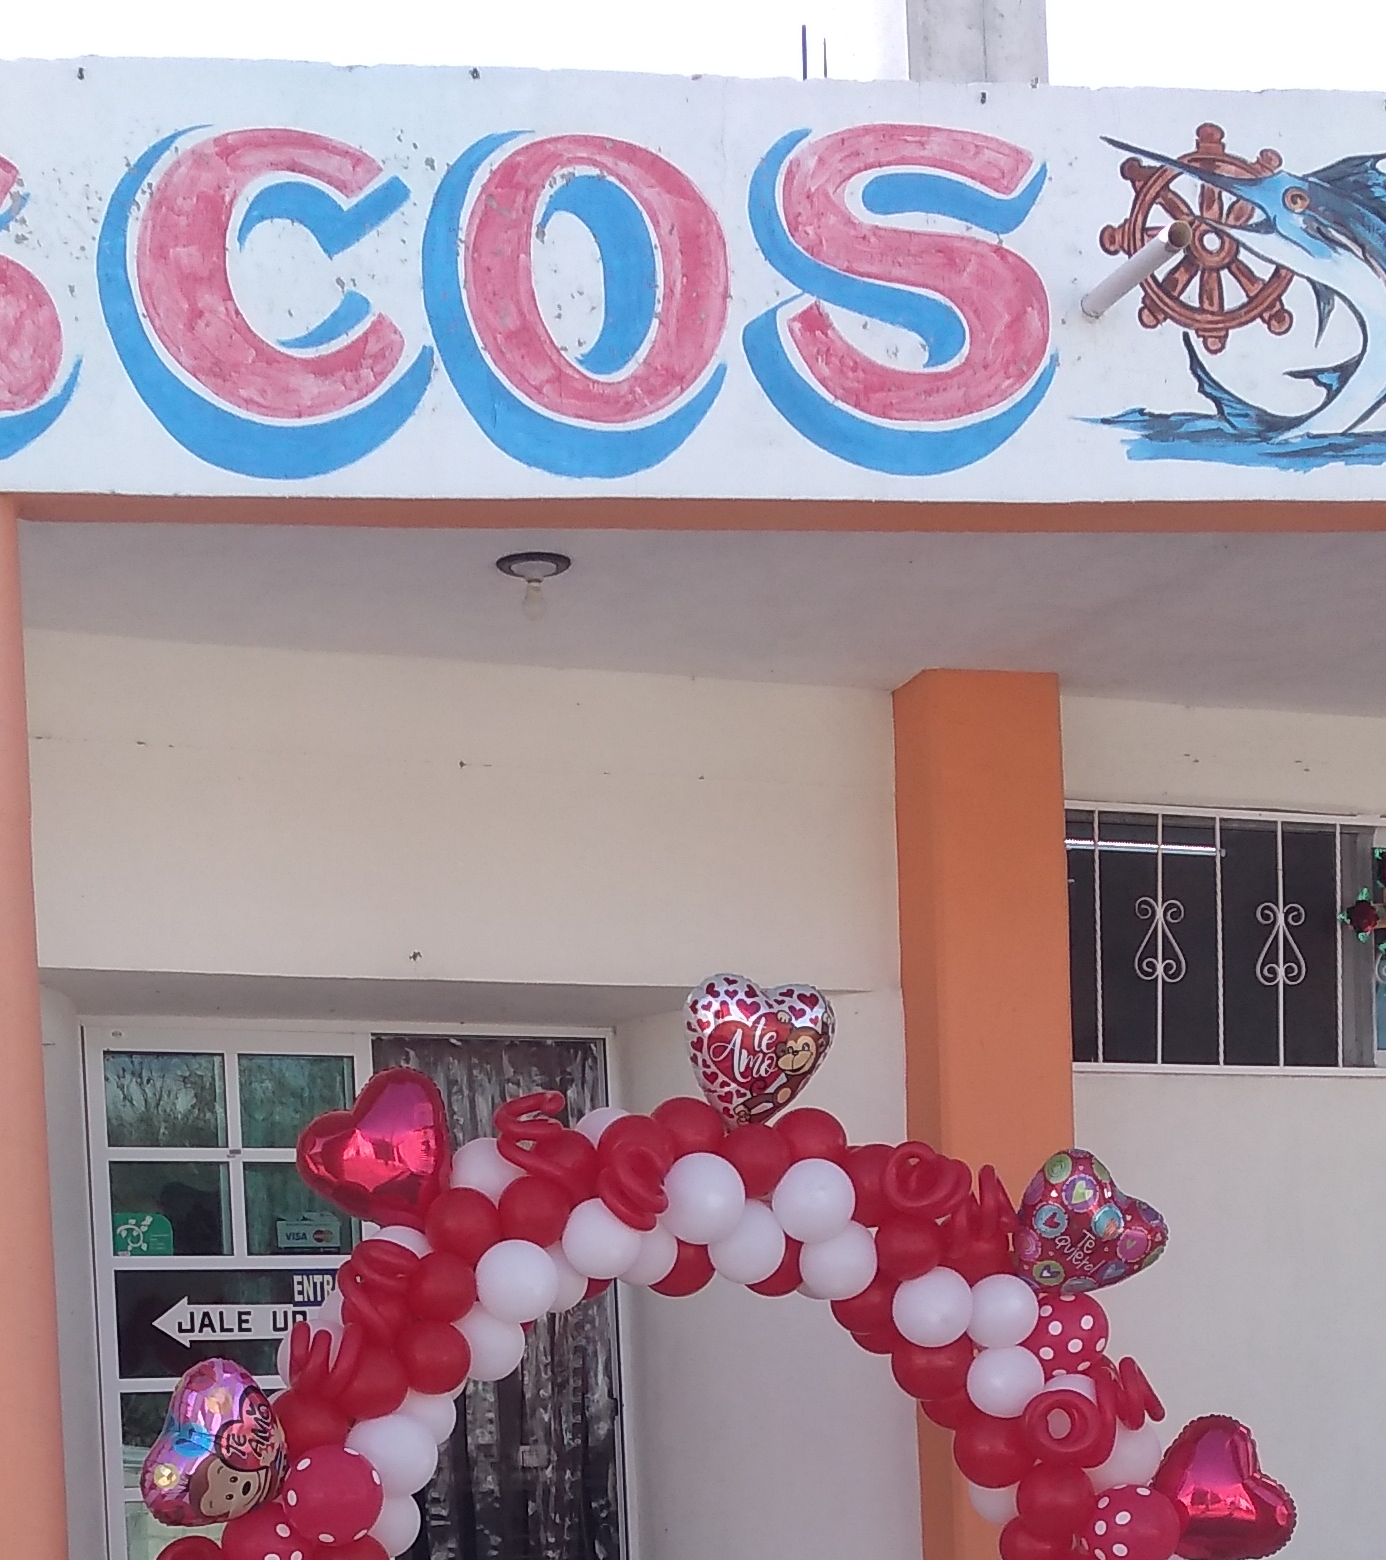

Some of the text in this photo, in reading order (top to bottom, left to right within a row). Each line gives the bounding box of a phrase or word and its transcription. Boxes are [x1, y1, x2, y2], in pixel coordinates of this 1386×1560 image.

[710, 1029, 778, 1083] Amo
[285, 1231, 308, 1241] VISA
[1078, 1229, 1096, 1253] Te
[177, 1310, 253, 1333] JALE
[248, 1402, 272, 1459] AMO
[225, 1433, 248, 1460] TE
